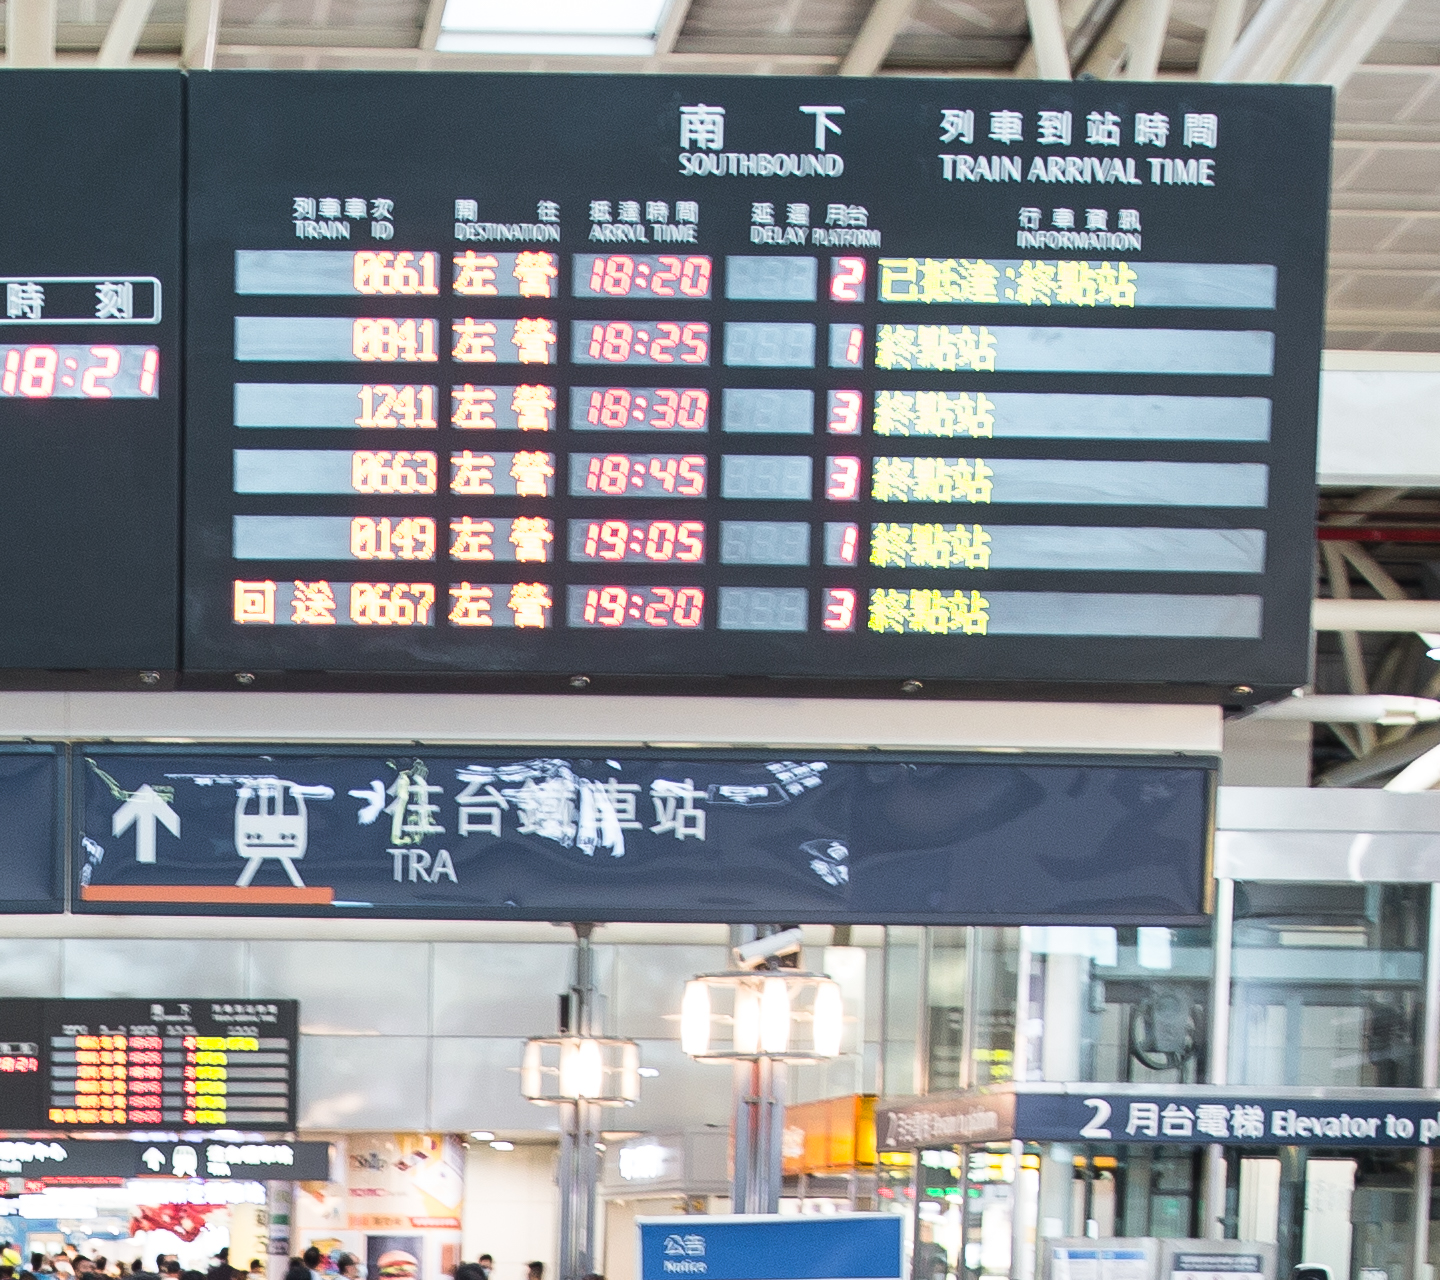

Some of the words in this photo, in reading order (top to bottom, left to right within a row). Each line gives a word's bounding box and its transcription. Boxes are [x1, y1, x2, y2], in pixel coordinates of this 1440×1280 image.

[679, 103, 846, 152] 南下
[939, 108, 1218, 148] 列車到站時間
[679, 153, 844, 178] SOUTHBOUND
[938, 154, 1021, 183] TRAIN
[1027, 156, 1143, 185] ARRIVAL
[1145, 158, 1216, 186] TIME
[293, 220, 351, 241] TRAIN
[370, 221, 394, 241] ID
[454, 222, 561, 243] DESTINATION
[825, 203, 869, 228] 月台
[651, 224, 699, 245] TIME
[749, 225, 809, 247] DELAY
[811, 227, 882, 249] PLATFORM
[1016, 229, 1142, 252] INFORMATION
[353, 251, 439, 294] 0661
[589, 255, 712, 297] 18:20
[831, 257, 866, 300] 2
[7, 281, 134, 320] 時刻
[352, 318, 438, 362] 0841
[588, 322, 709, 363] 18:25
[846, 328, 863, 365] 1
[1, 347, 158, 398] 18:21
[355, 384, 438, 430] 1241
[586, 389, 709, 430] 18:30
[828, 390, 861, 434] 3
[350, 450, 438, 495] 0663
[585, 455, 706, 496] 18:45
[828, 456, 860, 500] 3
[349, 516, 437, 561] 0149
[585, 521, 706, 562] 19:05
[839, 526, 856, 563] 1
[350, 583, 435, 624] 0667
[584, 587, 704, 628] 19:20
[824, 588, 856, 632] 3
[386, 849, 459, 883] TRA
[1080, 1098, 1112, 1139] 2
[1124, 1101, 1265, 1139] 月台電梯
[1271, 1109, 1381, 1138] Elevator
[1384, 1109, 1415, 1139] to
[664, 1234, 706, 1257] 公告
[664, 1259, 707, 1275] Notice
